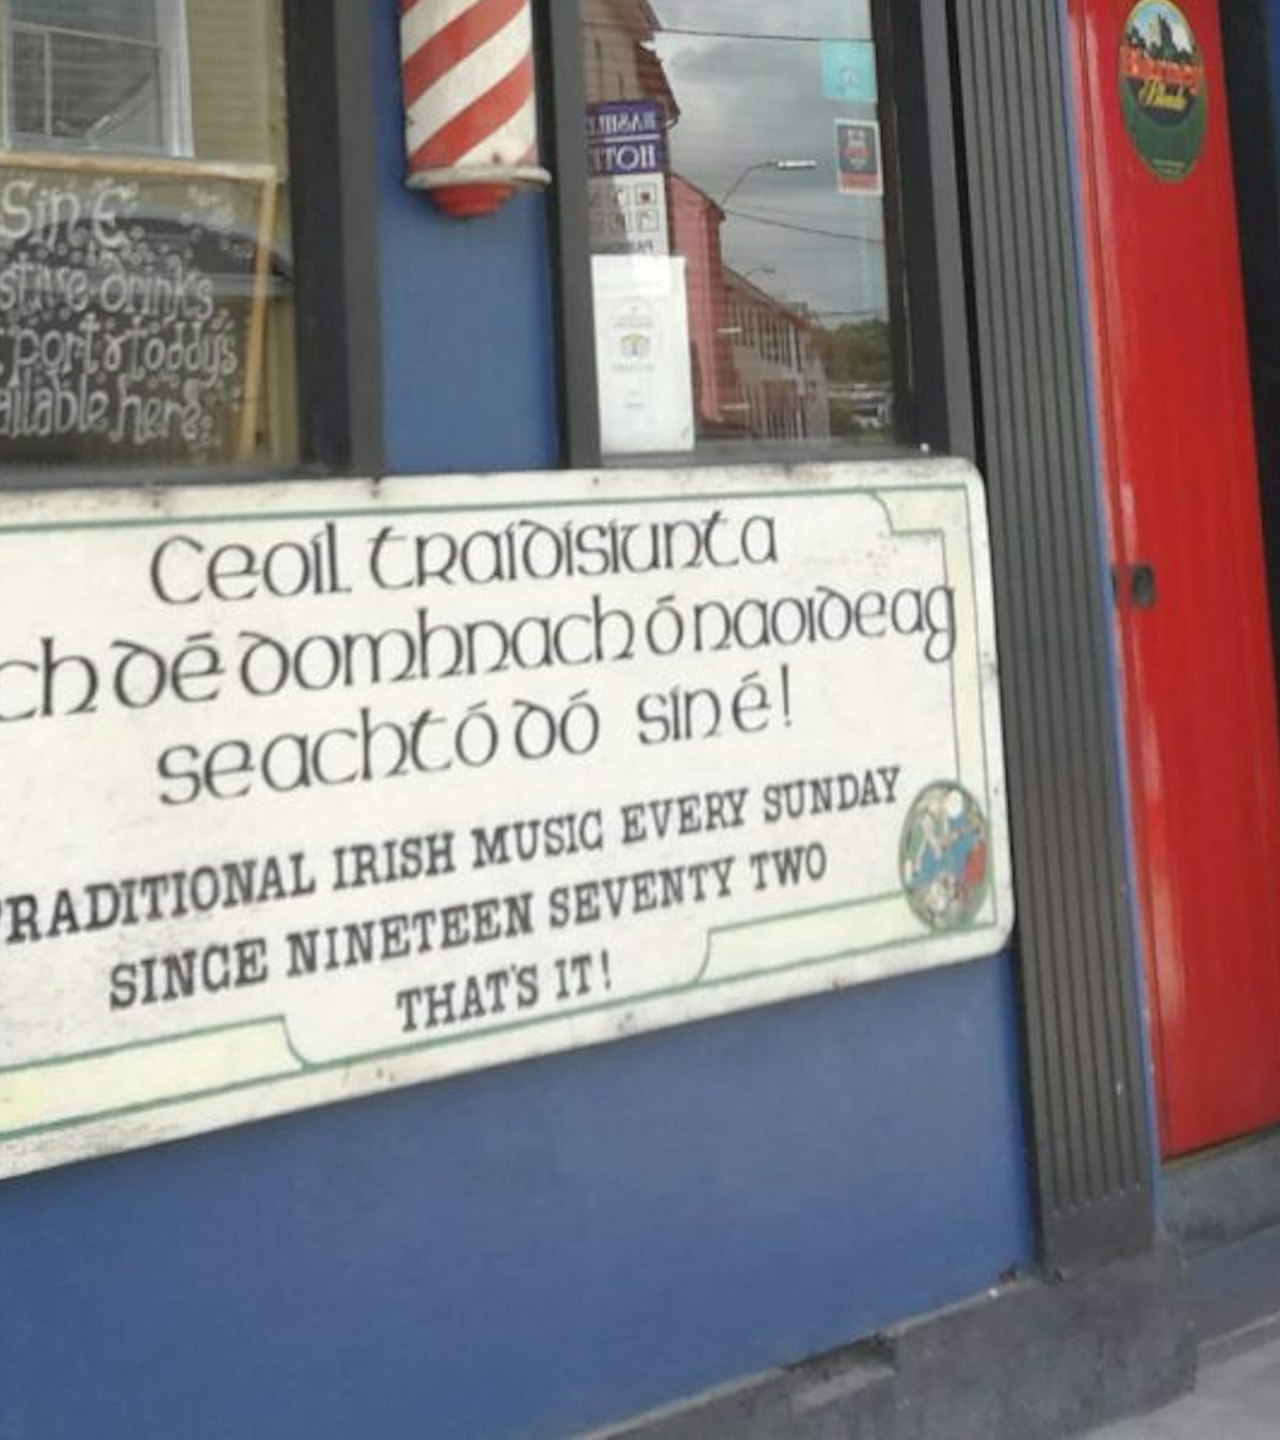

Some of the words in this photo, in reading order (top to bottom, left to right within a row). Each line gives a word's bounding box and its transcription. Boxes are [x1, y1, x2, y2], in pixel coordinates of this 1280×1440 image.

[150, 521, 352, 605] Ceoil
[331, 830, 457, 891] IRISH
[471, 809, 605, 869] MUSIC
[621, 786, 748, 845] EVERY
[762, 765, 902, 825] SUNDAY
[109, 938, 269, 1011] SINCE
[286, 891, 535, 975] NINETEEN
[549, 856, 737, 929] SEVENTY
[749, 841, 829, 891] TWO
[396, 964, 540, 1034] THAT'S
